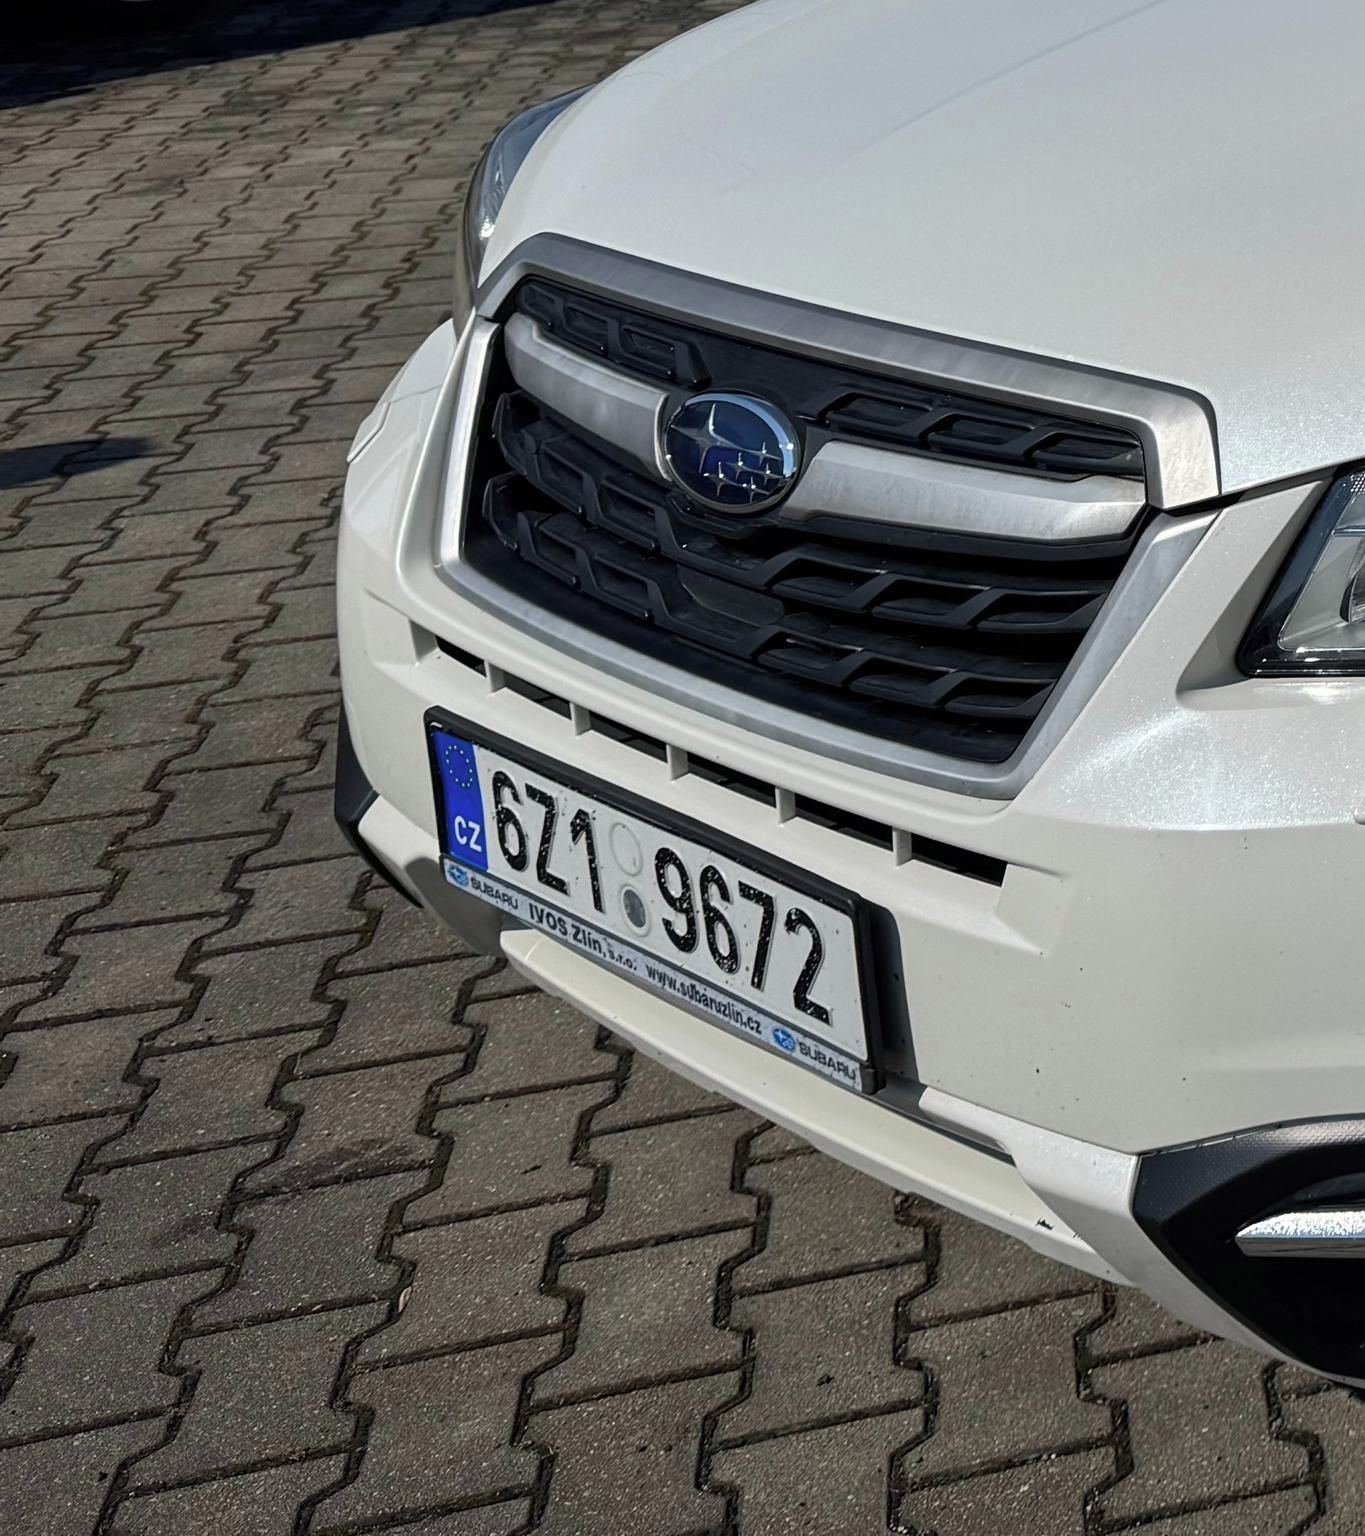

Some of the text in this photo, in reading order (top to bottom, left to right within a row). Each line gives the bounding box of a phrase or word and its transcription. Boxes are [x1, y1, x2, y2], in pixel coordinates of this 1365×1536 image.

[453, 813, 483, 853] CZ
[490, 770, 834, 1027] 6Z1 9672
[470, 876, 519, 911] SUBARU
[528, 902, 568, 939] IVOS
[645, 964, 762, 1035] www.subaruzlin.cz
[799, 1040, 857, 1081] SUBARU
